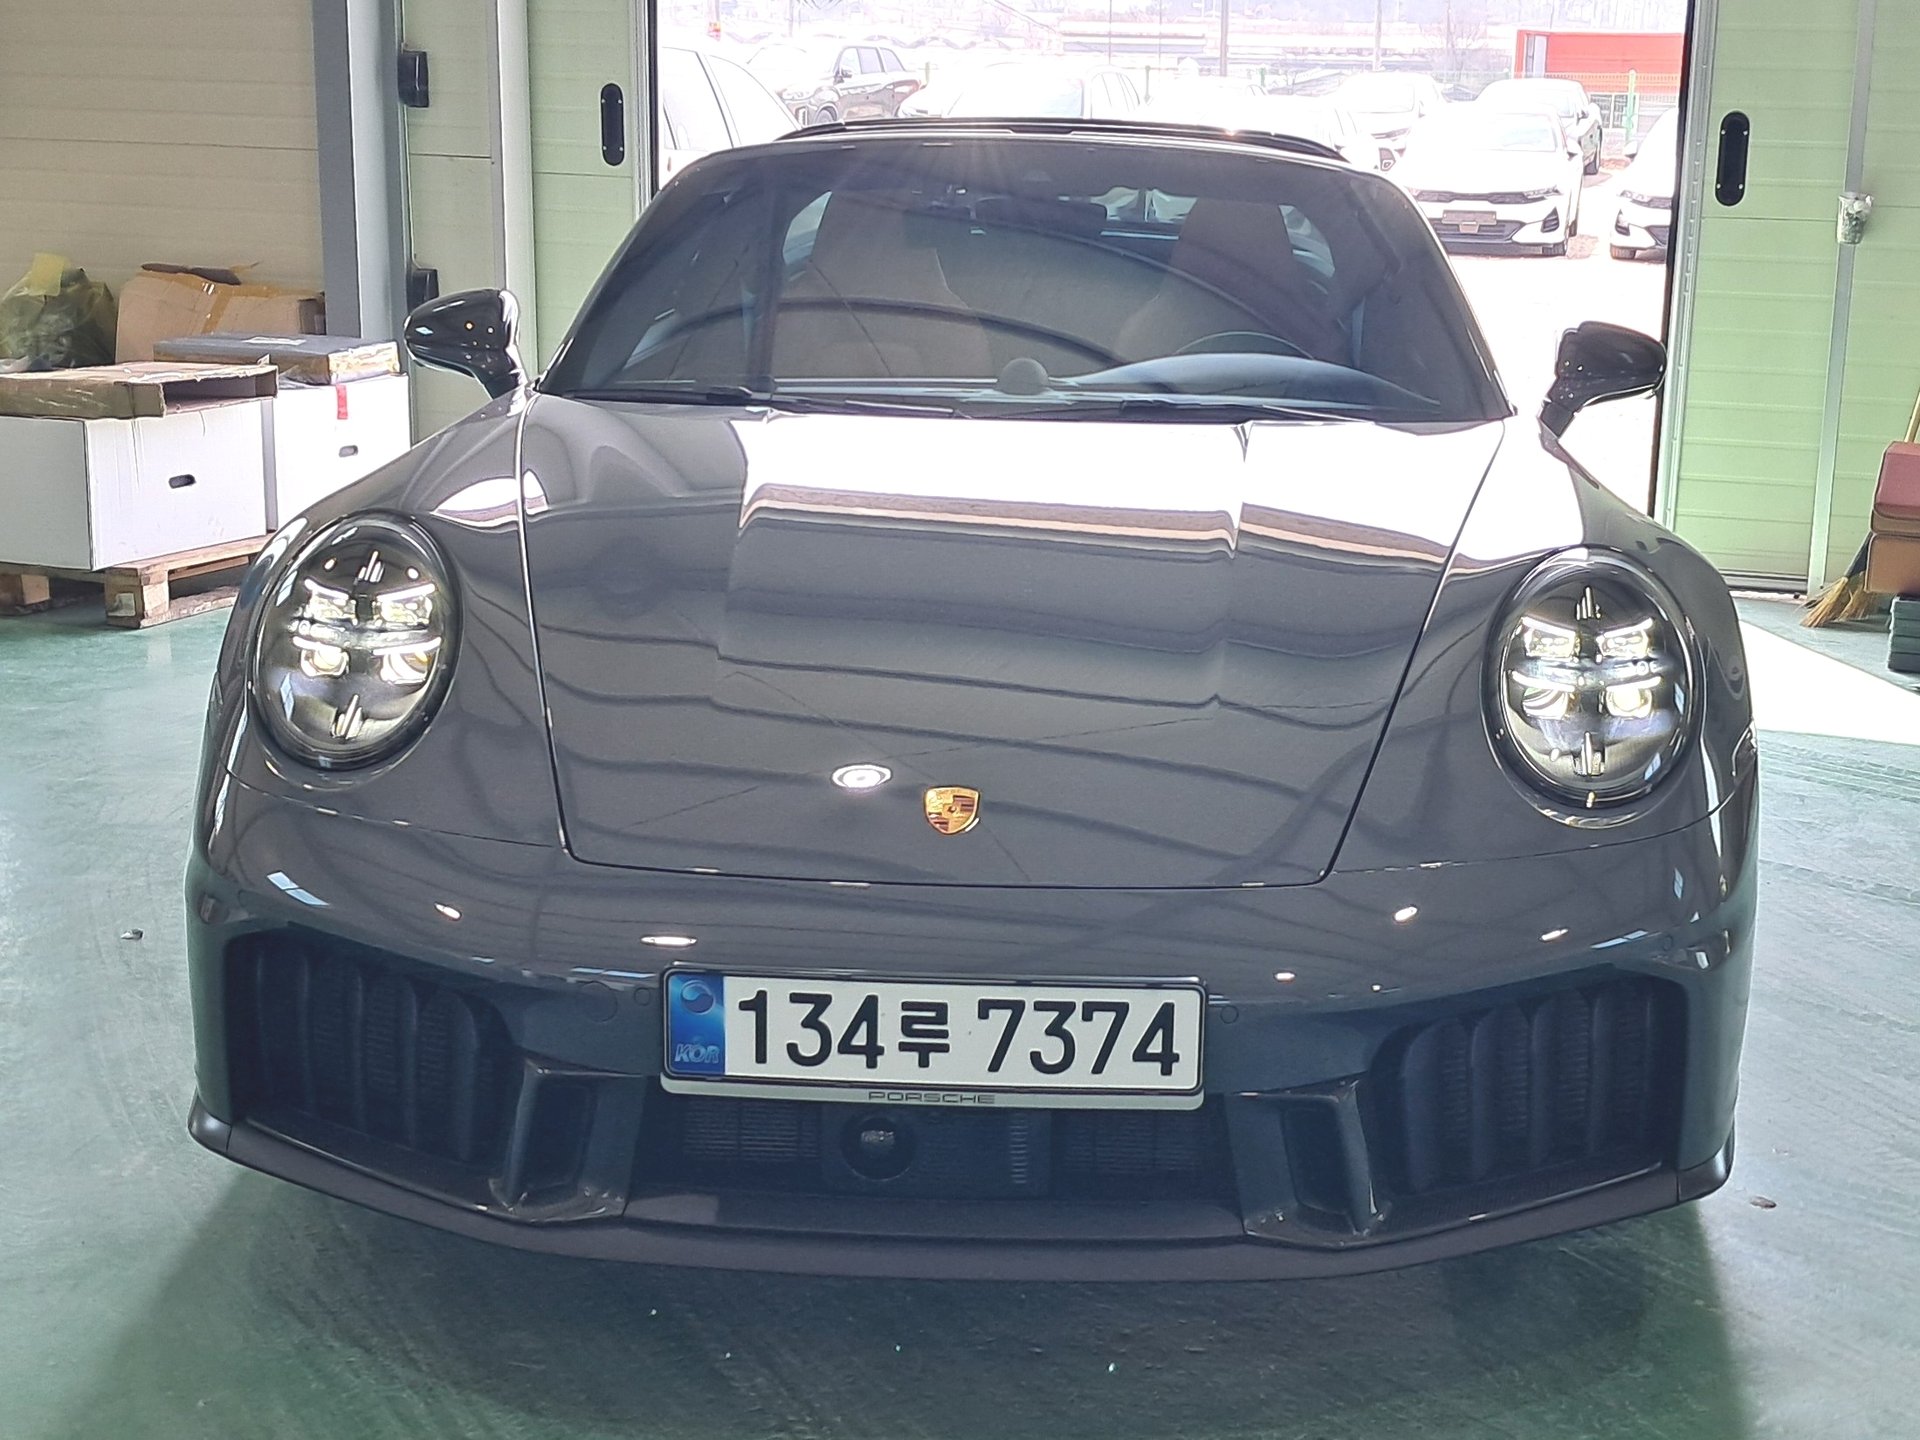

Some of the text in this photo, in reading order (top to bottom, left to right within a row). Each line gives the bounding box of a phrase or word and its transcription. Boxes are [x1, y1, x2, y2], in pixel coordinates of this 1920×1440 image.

[738, 989, 1180, 1077] 134루 7374
[674, 1043, 720, 1064] KOR
[868, 1091, 996, 1105] PORSCHE
